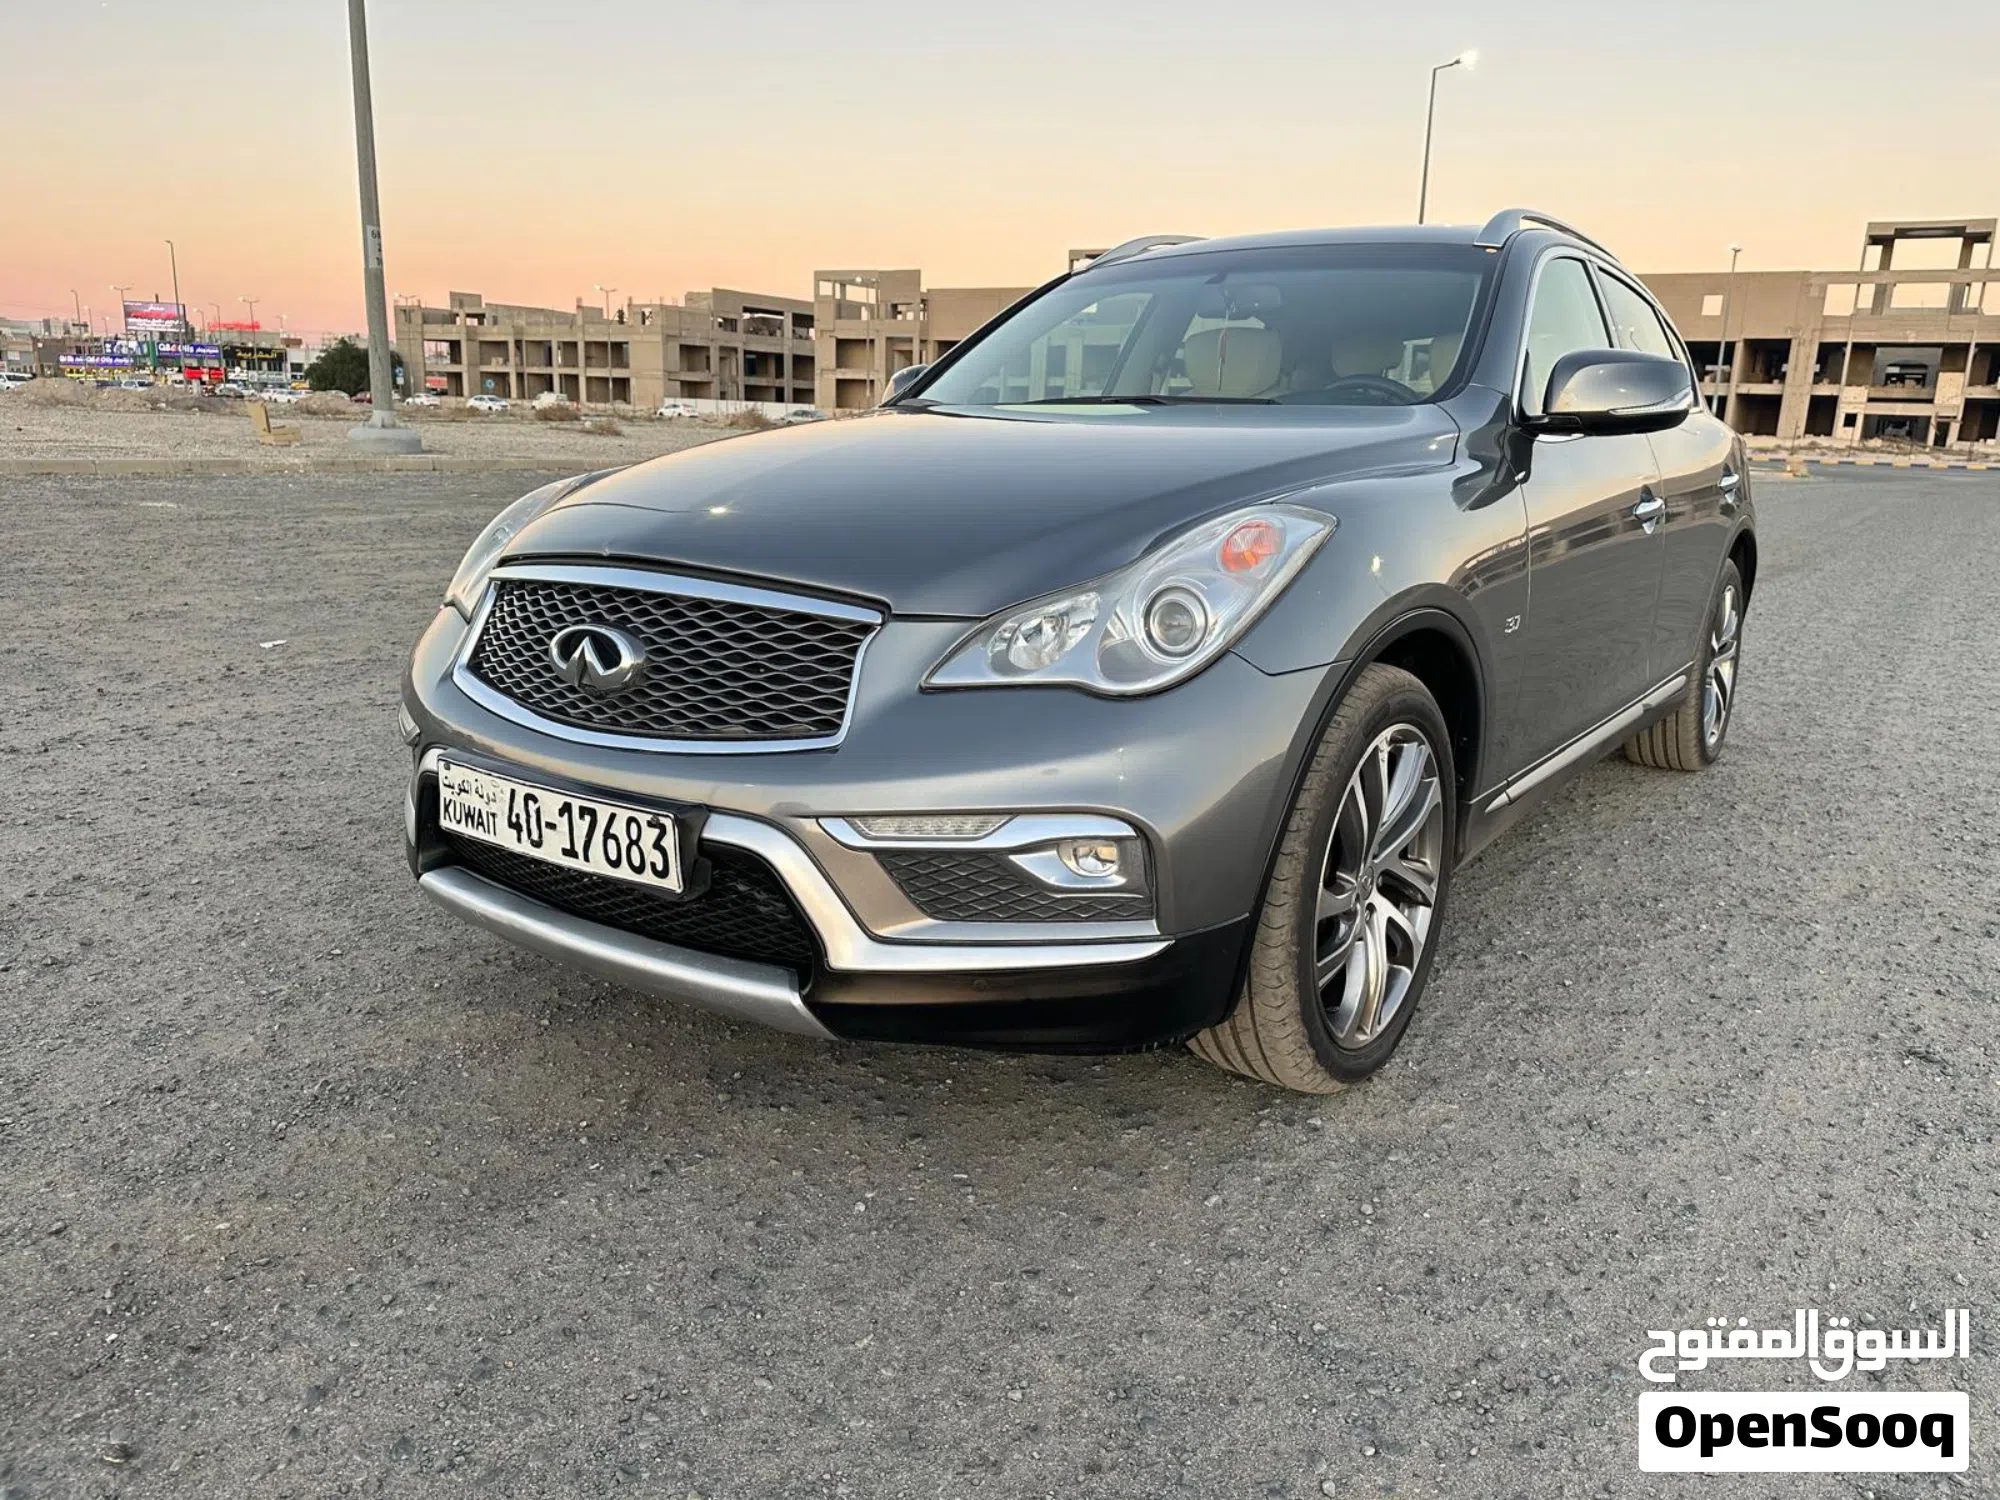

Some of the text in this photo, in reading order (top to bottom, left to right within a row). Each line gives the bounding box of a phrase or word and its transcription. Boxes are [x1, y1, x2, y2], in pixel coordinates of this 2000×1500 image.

[442, 775, 472, 797] الكويت
[443, 796, 497, 836] KUWAIT
[506, 788, 670, 880] 40-17683
